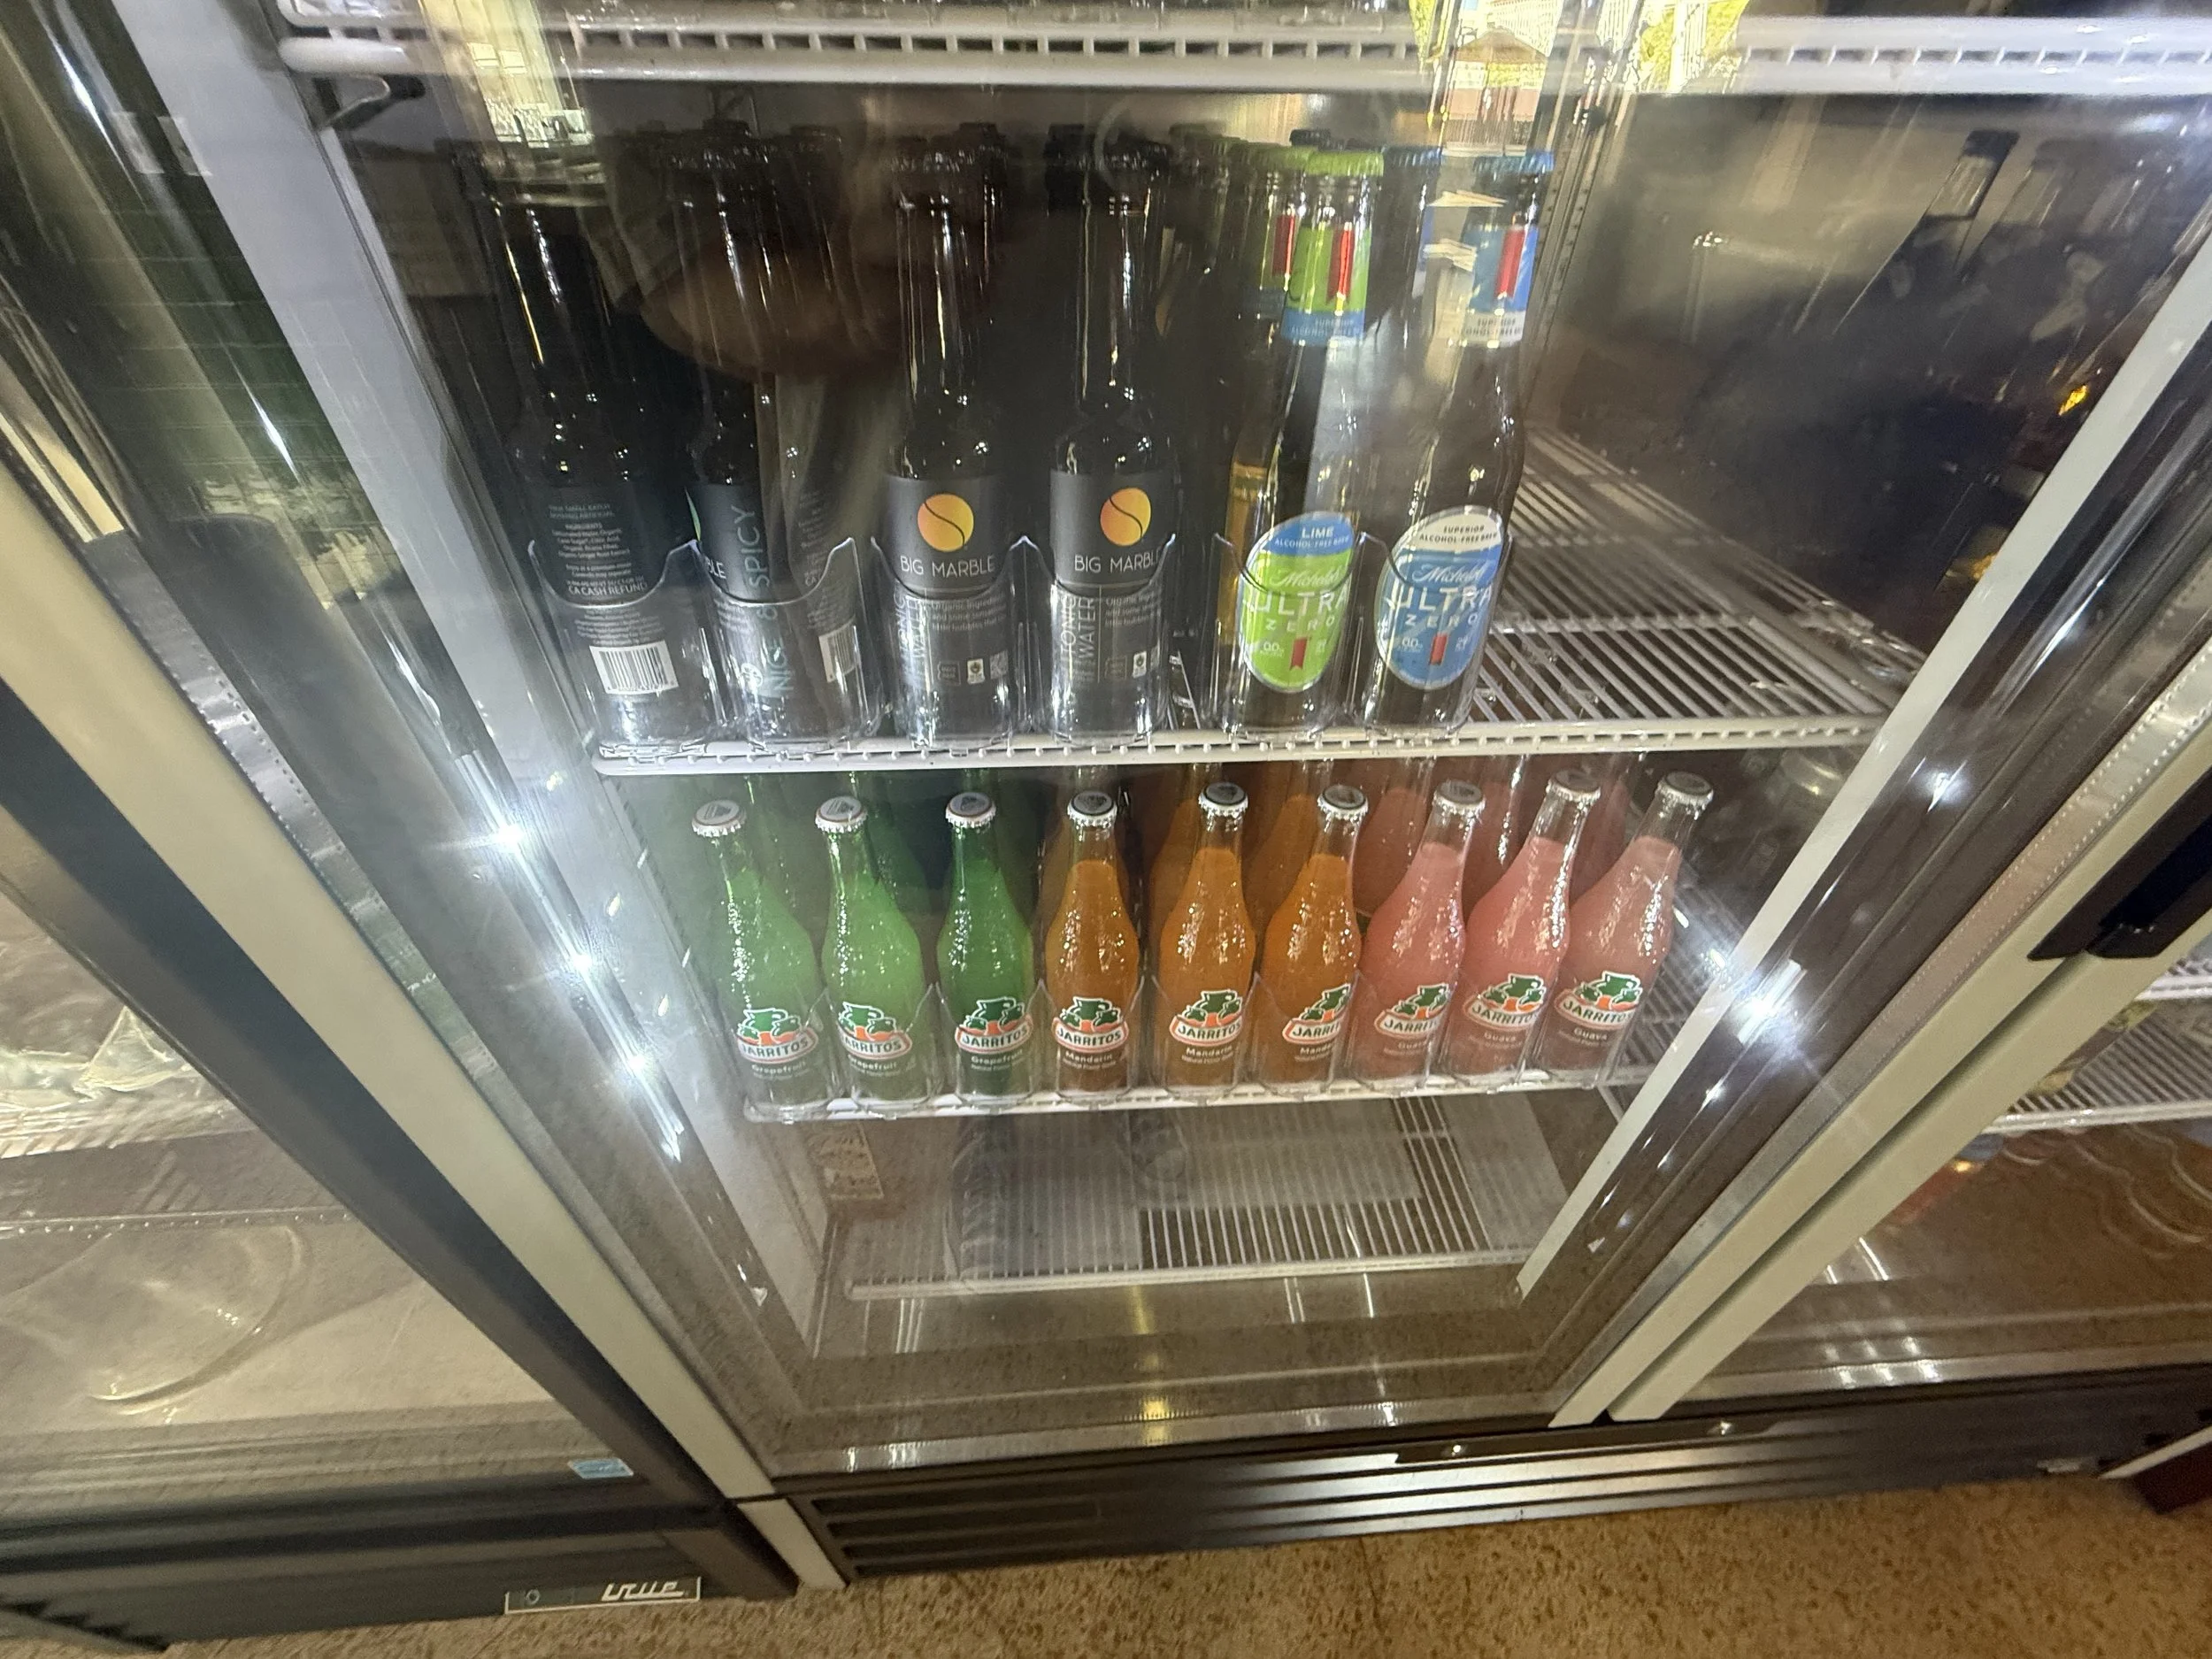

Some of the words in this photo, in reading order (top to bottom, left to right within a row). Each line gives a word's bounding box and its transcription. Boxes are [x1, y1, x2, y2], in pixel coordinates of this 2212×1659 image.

[1302, 526, 1334, 540] LIME
[1443, 524, 1485, 534] SUPERIOR
[731, 504, 770, 588] SPICY
[900, 556, 925, 576] BIG
[932, 555, 995, 578] MARBLE
[1074, 554, 1102, 573] BIG
[568, 584, 581, 595] CA
[580, 585, 607, 596] CASH
[608, 582, 648, 596] REFUND
[1078, 595, 1096, 659] WATER
[1265, 616, 1335, 633] ZERO
[1404, 612, 1478, 629] ZERO
[962, 1024, 1028, 1048] JARRITOS
[1056, 1027, 1123, 1046] JARRITOS
[1178, 1022, 1241, 1040] JARRITOS
[1484, 1030, 1517, 1043] Guava
[1573, 1026, 1608, 1041] Guava
[971, 1048, 1024, 1065] Grapefruit
[1065, 1049, 1113, 1064] Mandarin
[1186, 1044, 1233, 1057] Mandarin
[601, 1581, 684, 1601] true
